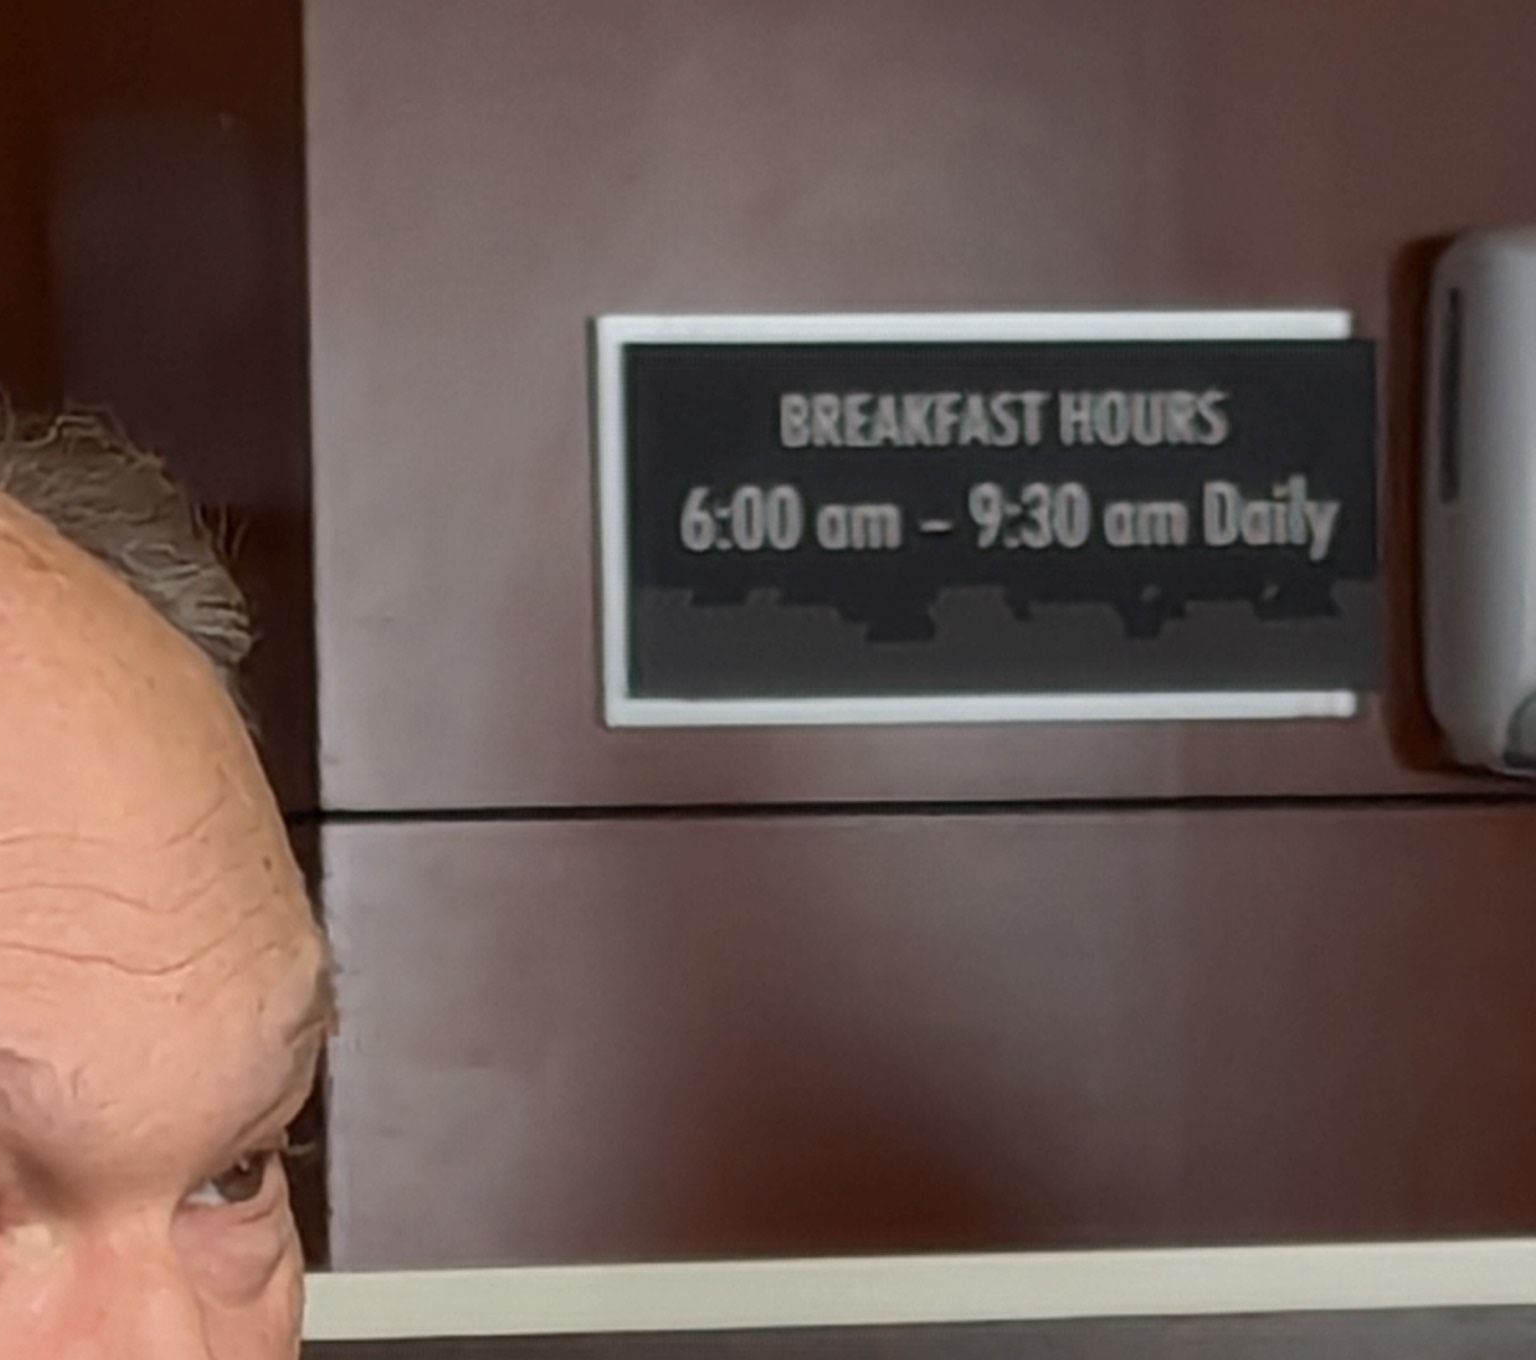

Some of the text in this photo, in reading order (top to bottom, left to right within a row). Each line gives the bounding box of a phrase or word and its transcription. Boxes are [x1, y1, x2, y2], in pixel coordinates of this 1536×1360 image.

[779, 387, 1230, 448] BREAKFAST HOURS
[678, 483, 804, 552] 6:00
[815, 500, 903, 551] am
[967, 480, 1092, 551] 9:30
[1102, 497, 1190, 548] am
[1202, 474, 1341, 563] Daily
